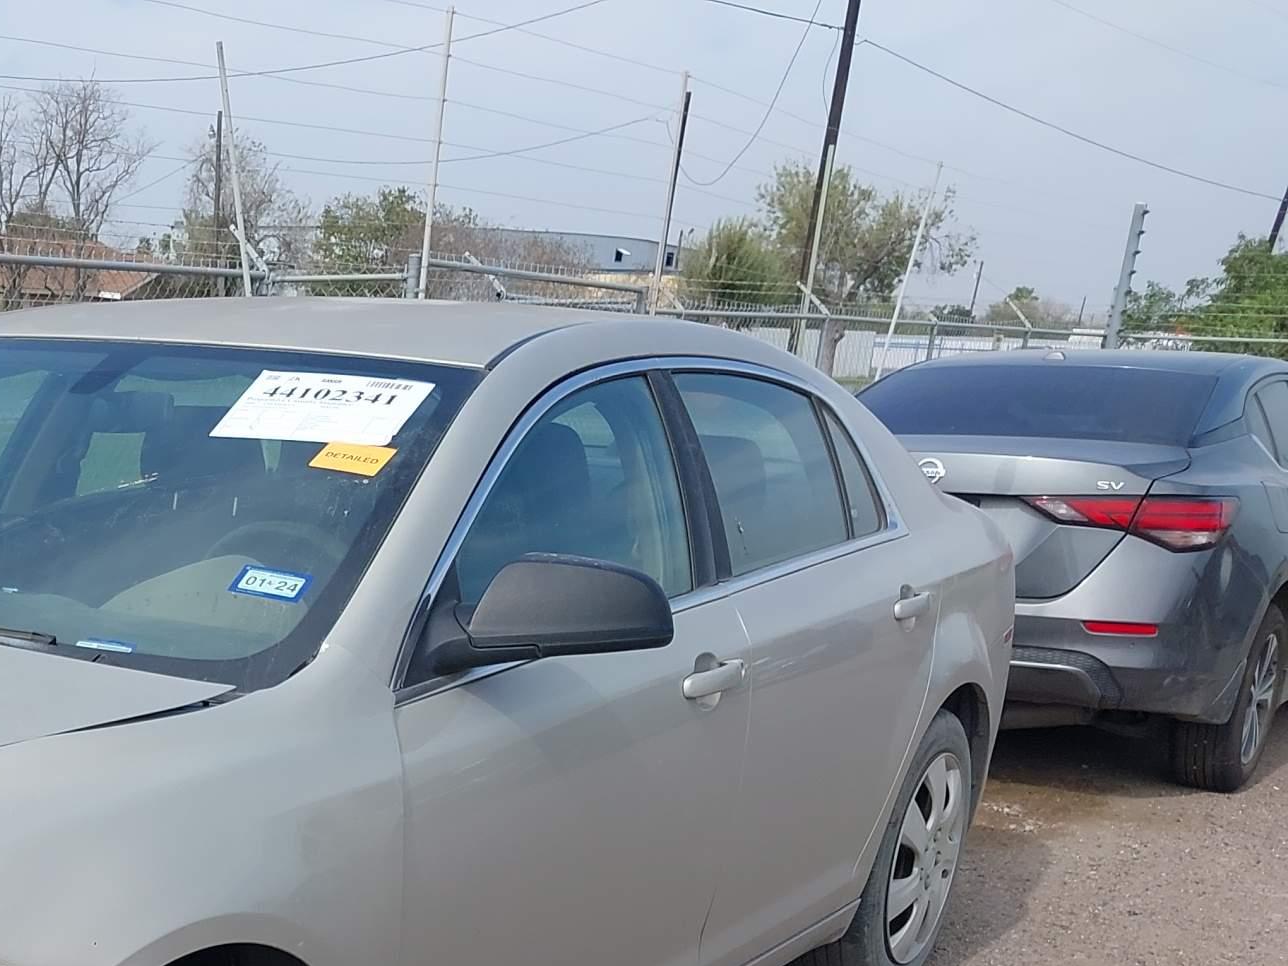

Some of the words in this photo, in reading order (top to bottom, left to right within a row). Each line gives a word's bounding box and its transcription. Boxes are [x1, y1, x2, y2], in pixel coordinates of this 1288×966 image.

[263, 385, 399, 406] 44102341
[324, 450, 380, 465] DETAILED
[1096, 480, 1125, 490] SV
